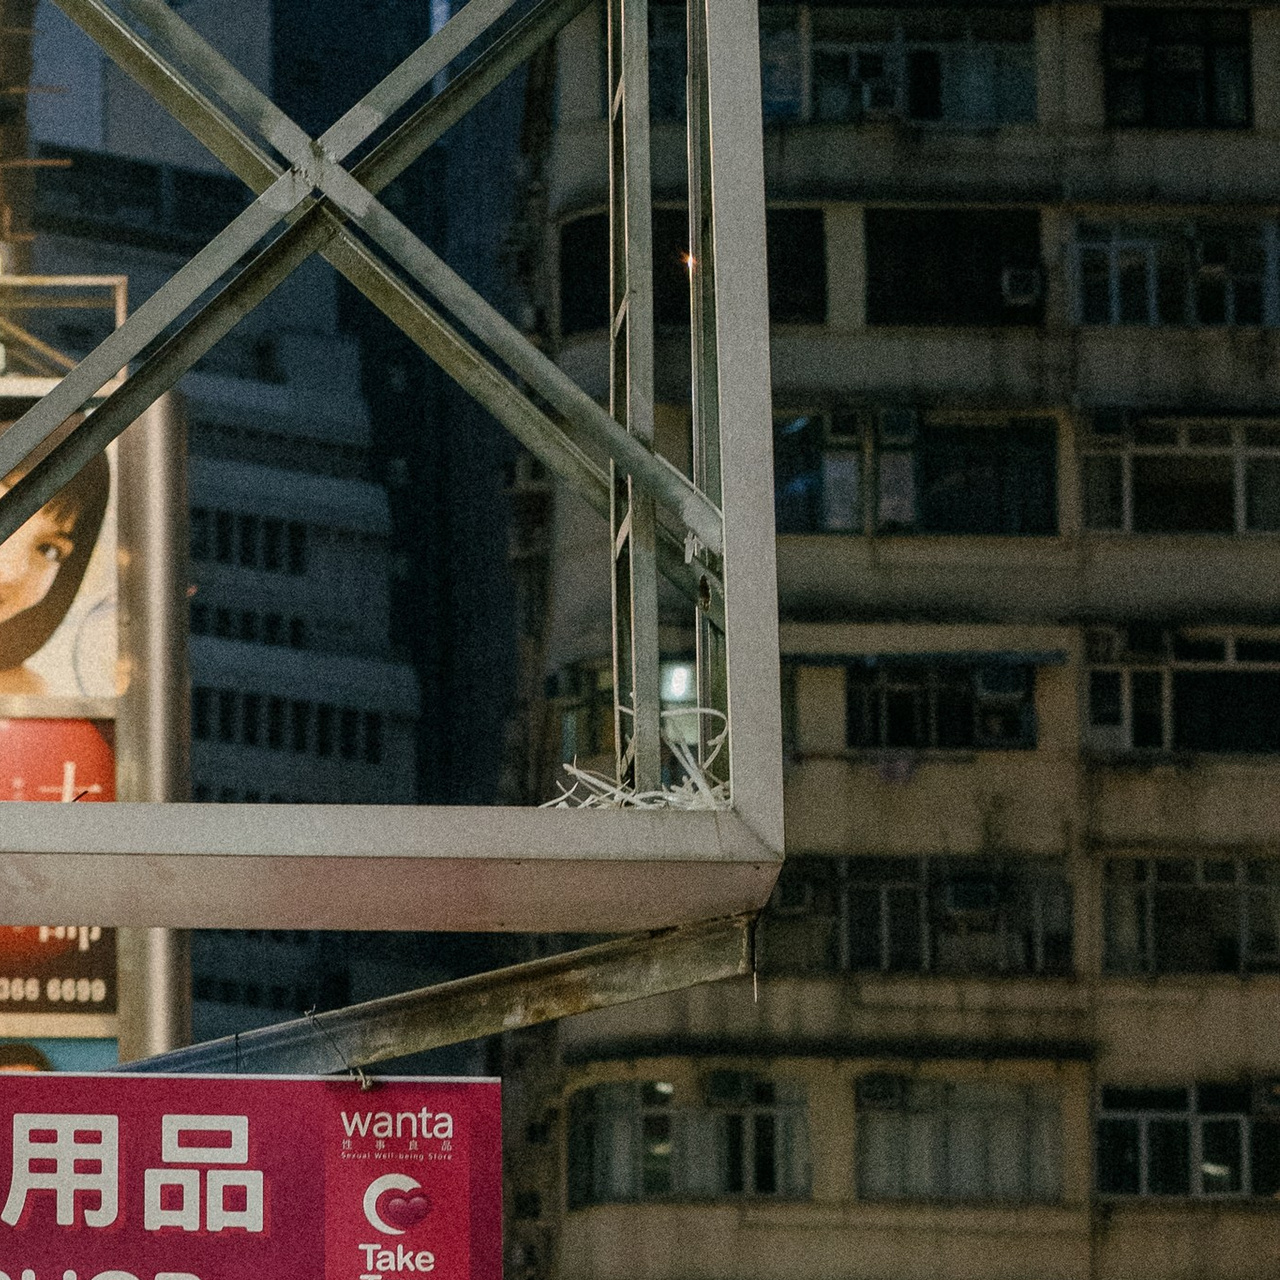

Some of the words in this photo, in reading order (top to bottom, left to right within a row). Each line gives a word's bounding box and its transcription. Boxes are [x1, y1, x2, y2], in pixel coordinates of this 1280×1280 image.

[340, 1106, 454, 1139] wanta
[340, 1151, 370, 1160] Sexual
[428, 1152, 453, 1161] Store
[358, 1244, 436, 1273] Take
